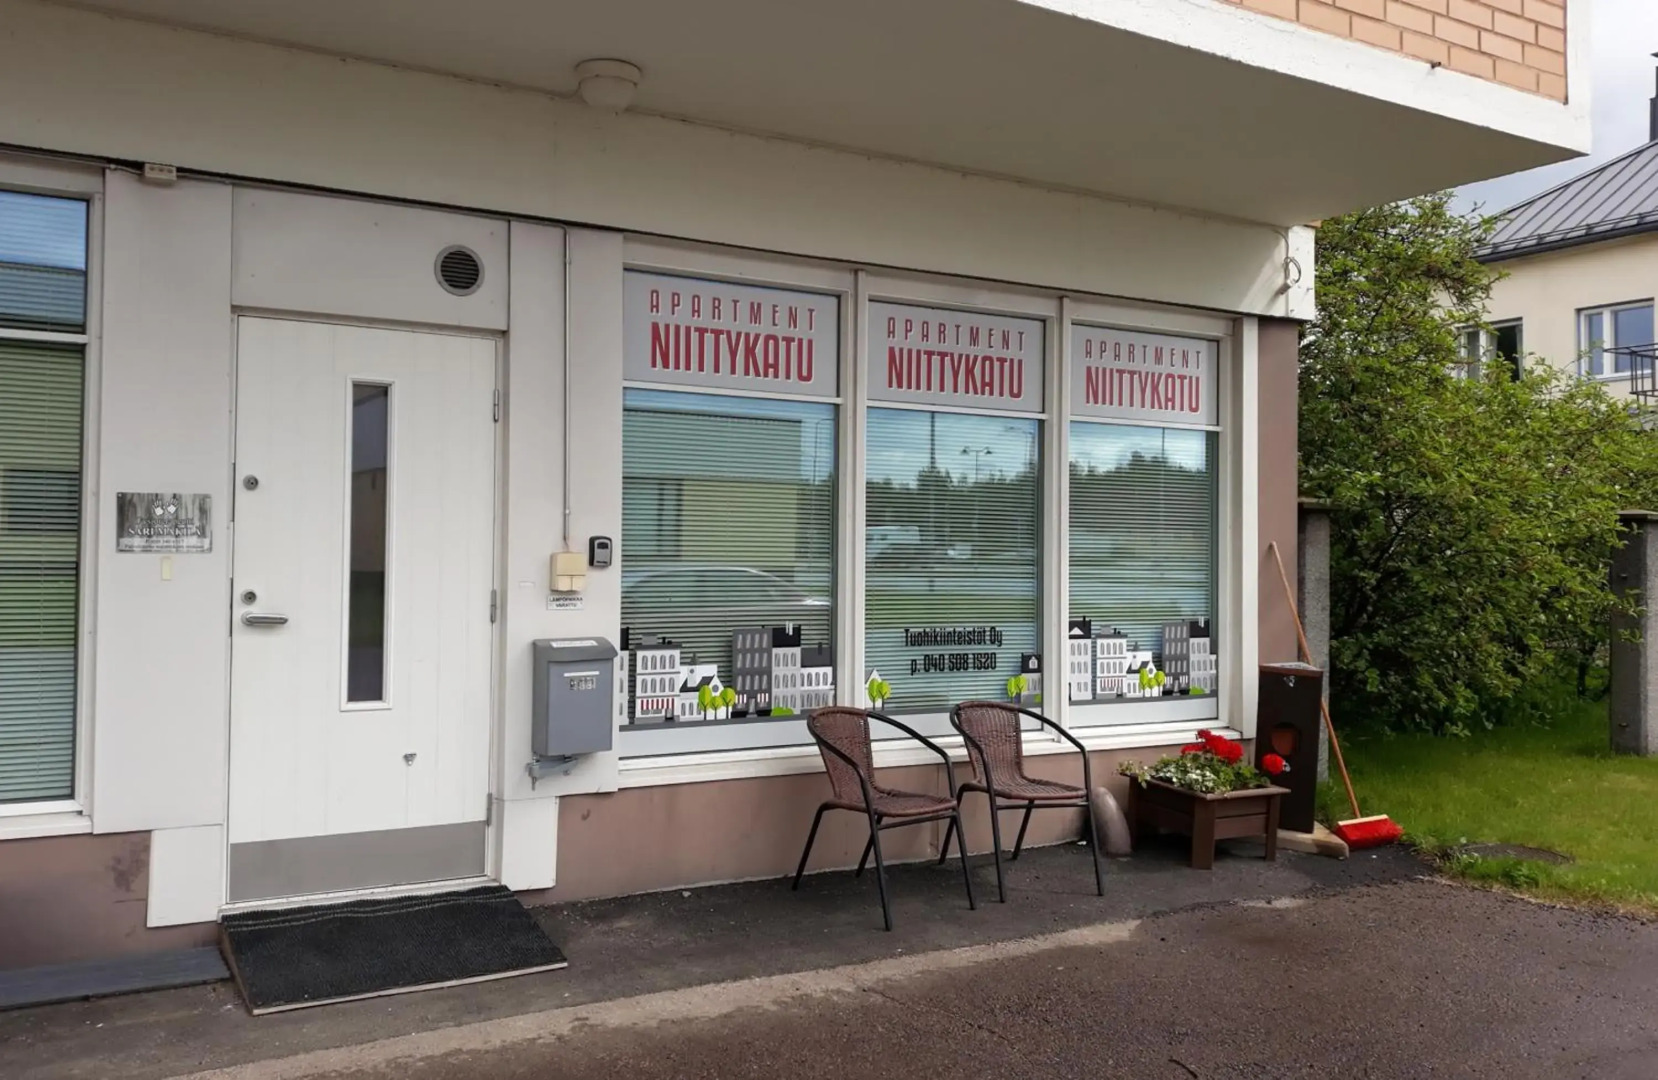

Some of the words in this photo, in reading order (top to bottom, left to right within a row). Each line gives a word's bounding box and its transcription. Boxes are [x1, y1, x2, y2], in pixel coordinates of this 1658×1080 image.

[650, 289, 816, 332] APARTMENT
[651, 321, 815, 383] NIITTYKATU
[887, 316, 1025, 352] APARTMENT
[887, 346, 1024, 399] NIITTYKATU
[1085, 338, 1202, 370] APARTMENT
[1085, 365, 1201, 413] NIITTYKATU
[904, 628, 987, 647] Tuohikiinteistöt
[989, 626, 1003, 647] Oy
[910, 659, 921, 676] p.
[923, 654, 945, 672] 040
[948, 653, 969, 671] 508
[972, 652, 997, 670] 1520
